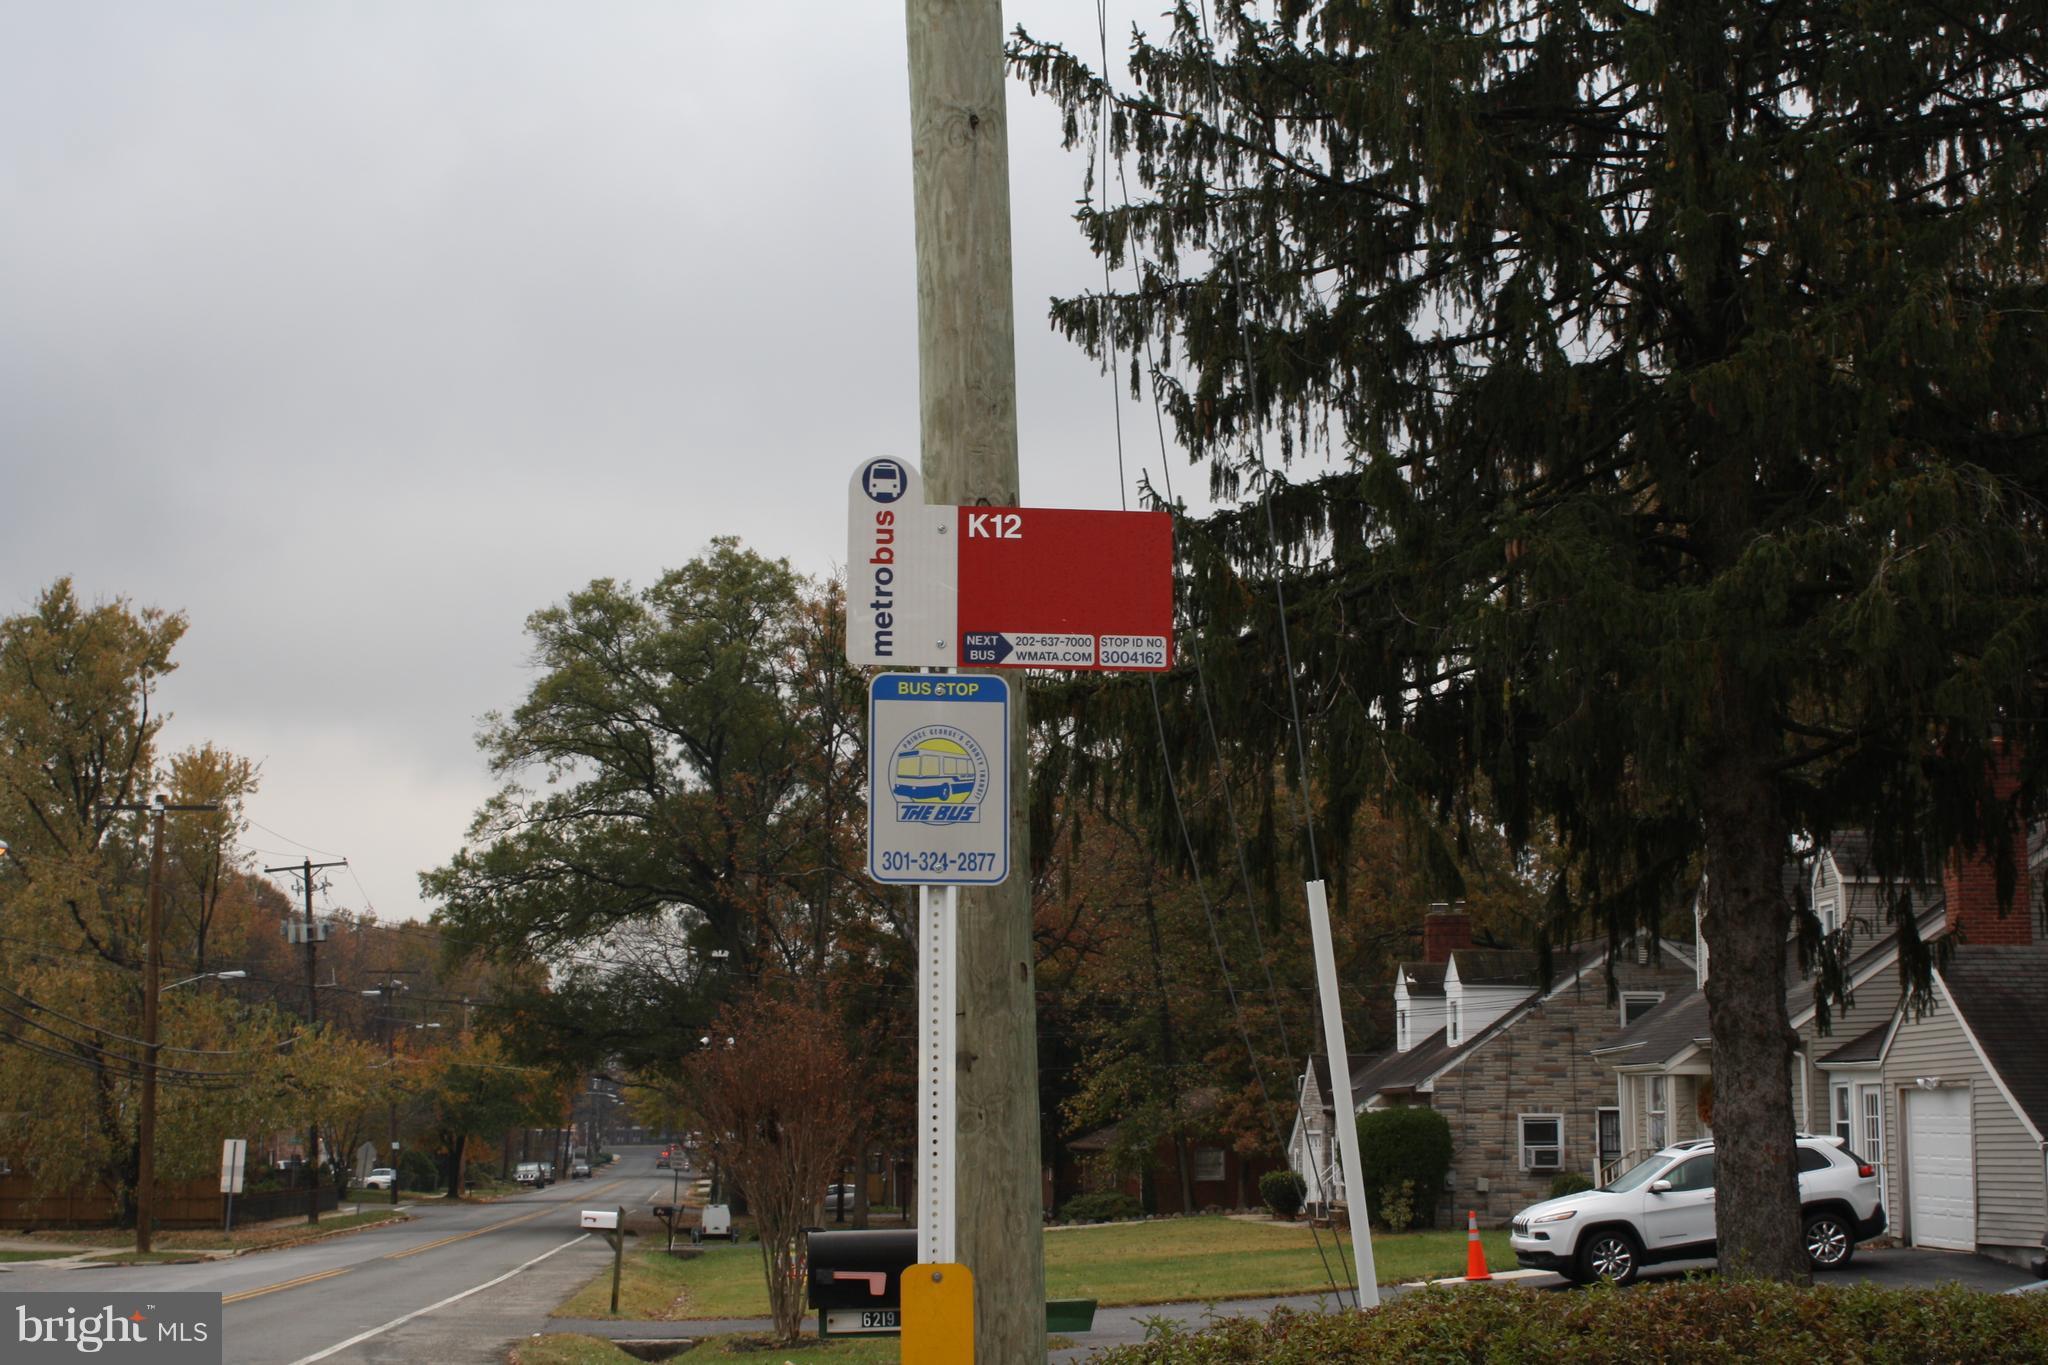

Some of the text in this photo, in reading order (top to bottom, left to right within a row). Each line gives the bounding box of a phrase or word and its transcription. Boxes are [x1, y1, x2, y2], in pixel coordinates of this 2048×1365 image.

[968, 514, 1022, 539] K12
[869, 510, 895, 657] metrobus
[966, 635, 999, 646] NEXT
[1015, 636, 1092, 647] 202-637-7000
[1101, 637, 1165, 649] STOP ID NO.
[970, 650, 996, 661] BUS
[1016, 651, 1092, 662] WMATA.COM
[1101, 650, 1163, 664] 3004162
[898, 681, 979, 696] BUS STOP
[901, 805, 977, 821] THE BUS
[882, 851, 996, 872] 301-324-2877
[863, 1312, 895, 1327] 6219
